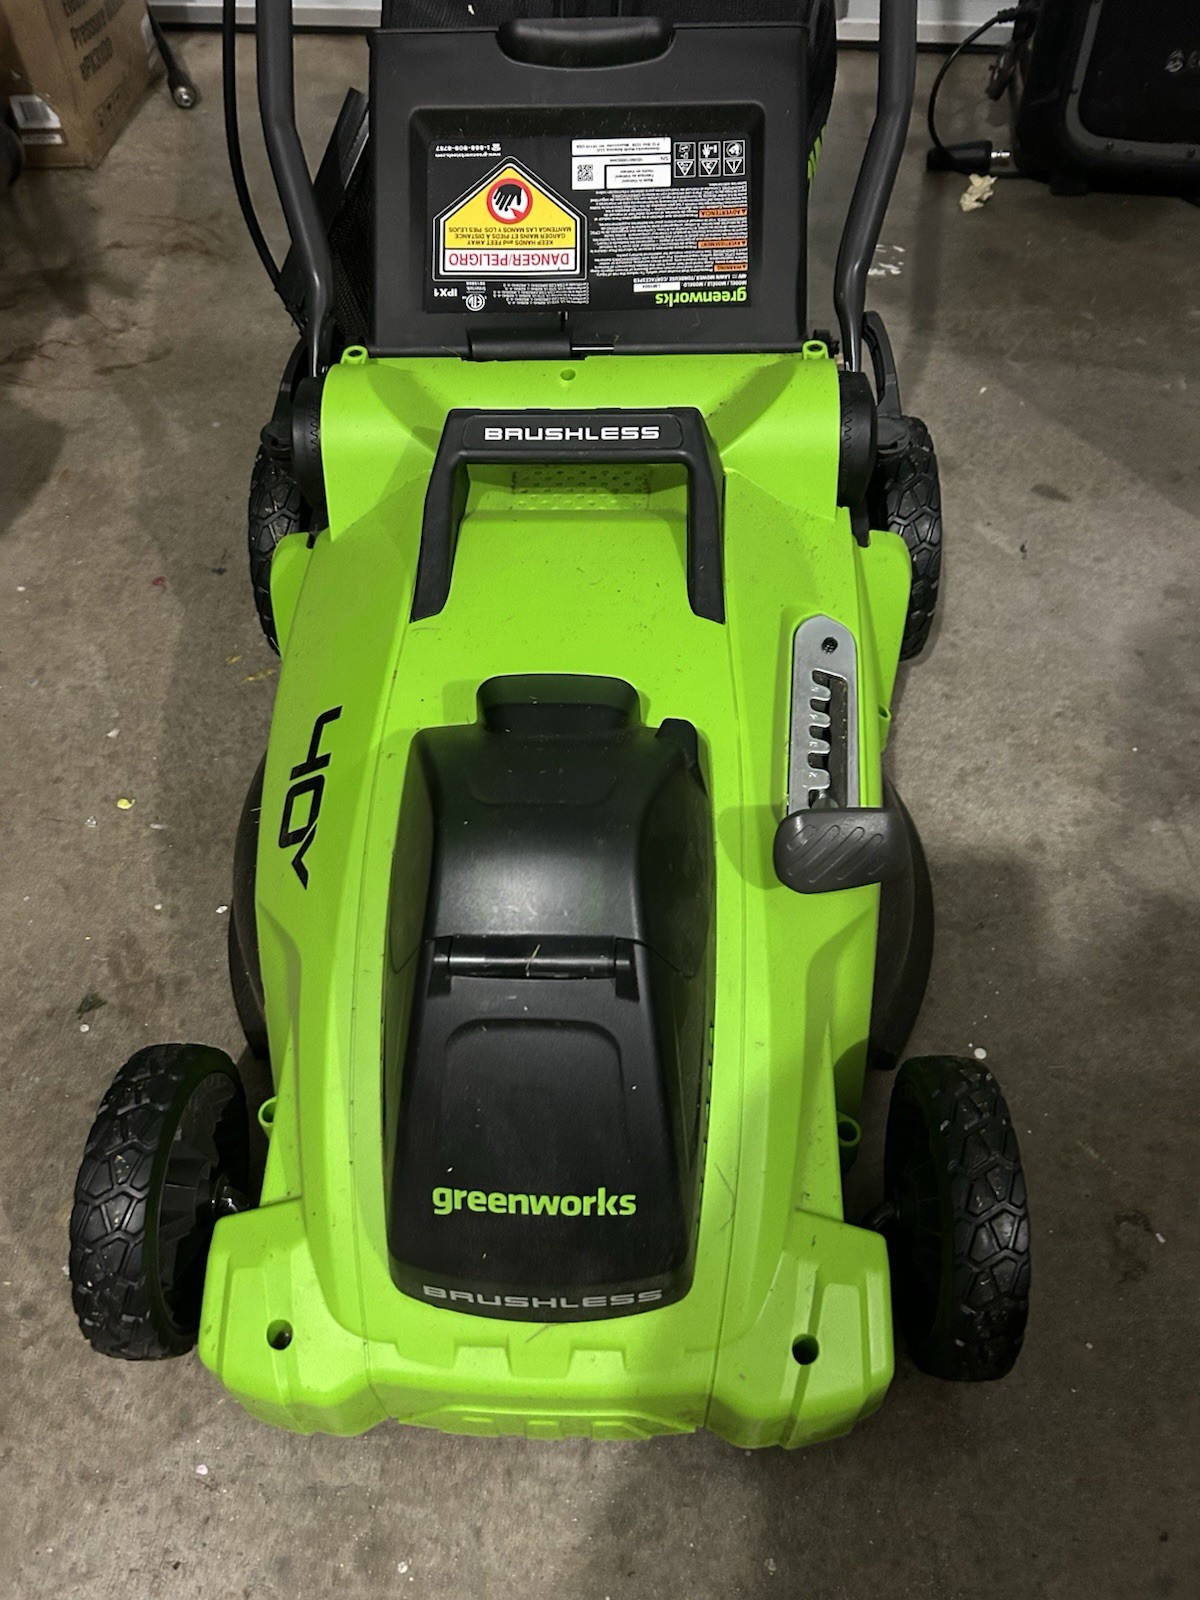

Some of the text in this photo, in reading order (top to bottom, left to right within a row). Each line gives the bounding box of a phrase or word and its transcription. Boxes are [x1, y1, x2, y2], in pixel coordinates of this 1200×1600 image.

[449, 253, 569, 266] DANGER/PELIGRO
[434, 288, 458, 296] IPX1
[655, 287, 747, 307] greenworks
[484, 426, 660, 441] BRUSHLESS
[278, 705, 343, 890] 40V
[432, 1187, 637, 1216] greenworks
[423, 1285, 663, 1308] BRUSHLESS
